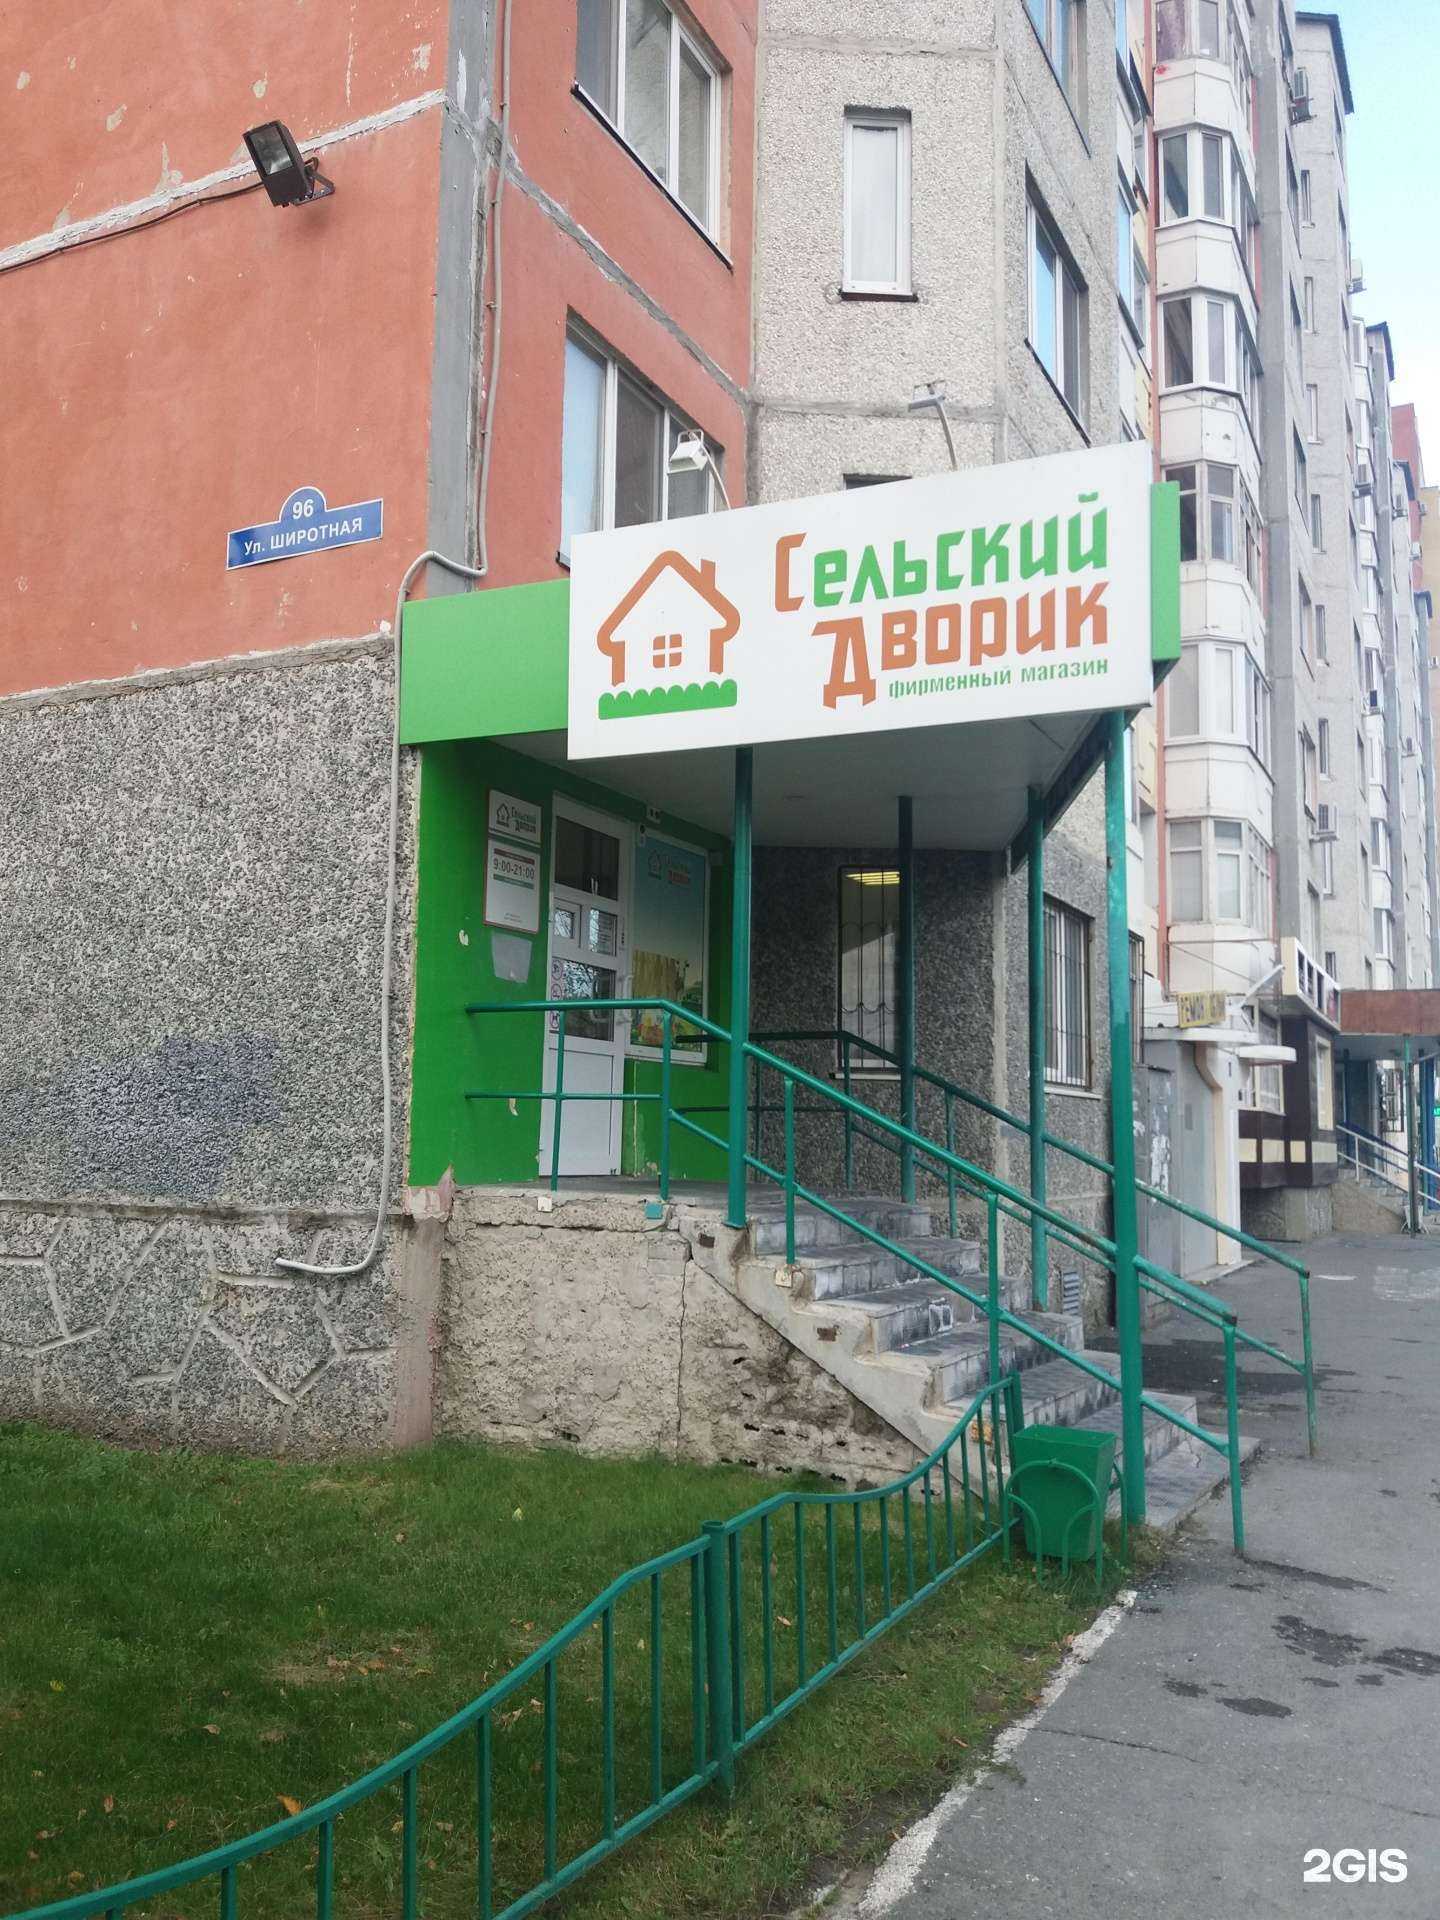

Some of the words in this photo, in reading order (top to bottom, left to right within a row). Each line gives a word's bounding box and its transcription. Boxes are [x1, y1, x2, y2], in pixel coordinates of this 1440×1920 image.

[292, 499, 314, 520] 96
[244, 540, 265, 556] Ул.
[270, 517, 363, 550] ШИРОТНАЯ
[774, 491, 1109, 613] Сельский
[811, 581, 1110, 710] Дворик
[888, 665, 1012, 699] фирменный
[1021, 658, 1109, 684] магазин
